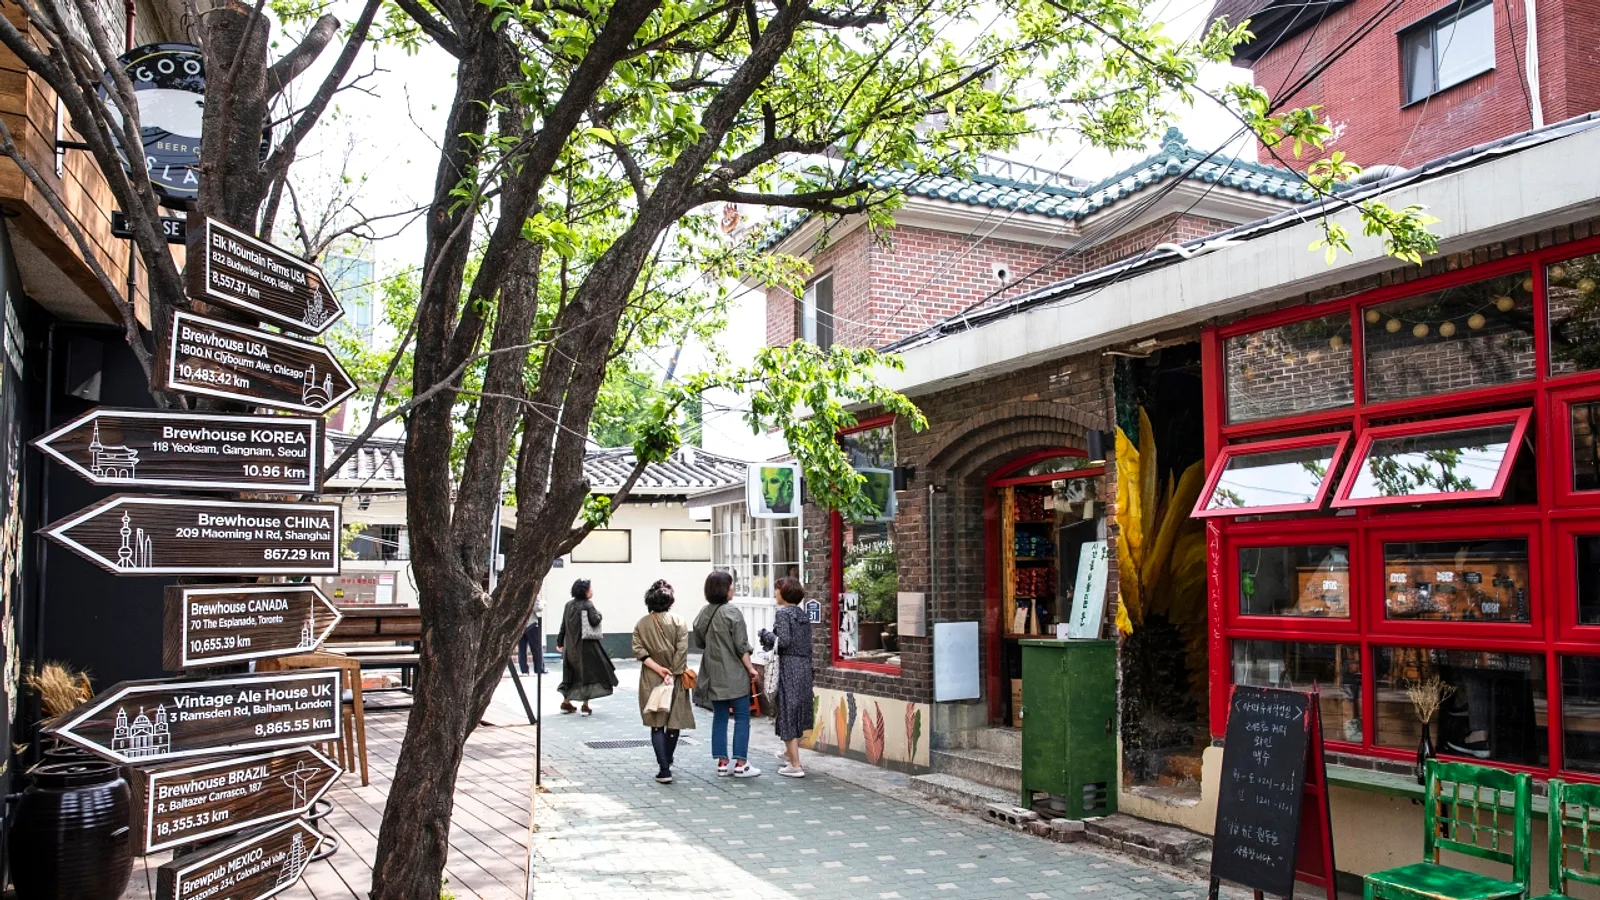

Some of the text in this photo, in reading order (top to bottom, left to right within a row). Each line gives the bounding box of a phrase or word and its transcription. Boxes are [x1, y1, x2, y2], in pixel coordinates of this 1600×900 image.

[157, 141, 188, 153] BEER
[212, 233, 306, 286] Elk Mountain Farms USA
[212, 252, 294, 294] 822 Budweiser Loop, Idaho
[212, 271, 260, 300] 8,557.37 km
[182, 326, 269, 358] Brewhouse USA
[180, 344, 304, 379] 1800 N Clybourn Ave, Chicago
[178, 364, 250, 389] 10,483.42 km
[162, 426, 306, 444] Brewhouse KOREA
[152, 442, 307, 458] 118 Yeoksam, Gangnam, Seoul
[242, 465, 306, 478] 10.96 km
[198, 513, 330, 529] Brewhouse CHINA
[176, 528, 331, 541] 209 Maoming N Rd, Shanghai
[263, 548, 330, 560] 867.29 km
[191, 598, 289, 616] Brewhouse CANADA
[809, 611, 816, 620] 31
[190, 615, 284, 630] 70 The Esplanade, Toronto
[190, 635, 251, 654] 10,655.39 km
[174, 684, 332, 709] Vintage Ale House UK
[170, 699, 332, 722] 3 Ramsden Rd, Balham, London
[254, 718, 332, 738] 8,865.55 km
[1254, 736, 1272, 748] 와인
[158, 765, 270, 800] Brewhouse BRAZIL
[158, 802, 168, 814] R.
[208, 787, 248, 802] Carrasco,
[249, 782, 263, 793] 187
[156, 808, 229, 836] 18,355.33 km
[182, 847, 263, 895] Brewpub MEXICO
[220, 876, 235, 893] 234,
[236, 864, 260, 881] Colonia
[260, 858, 272, 870] Del
[272, 852, 287, 865] Valle
